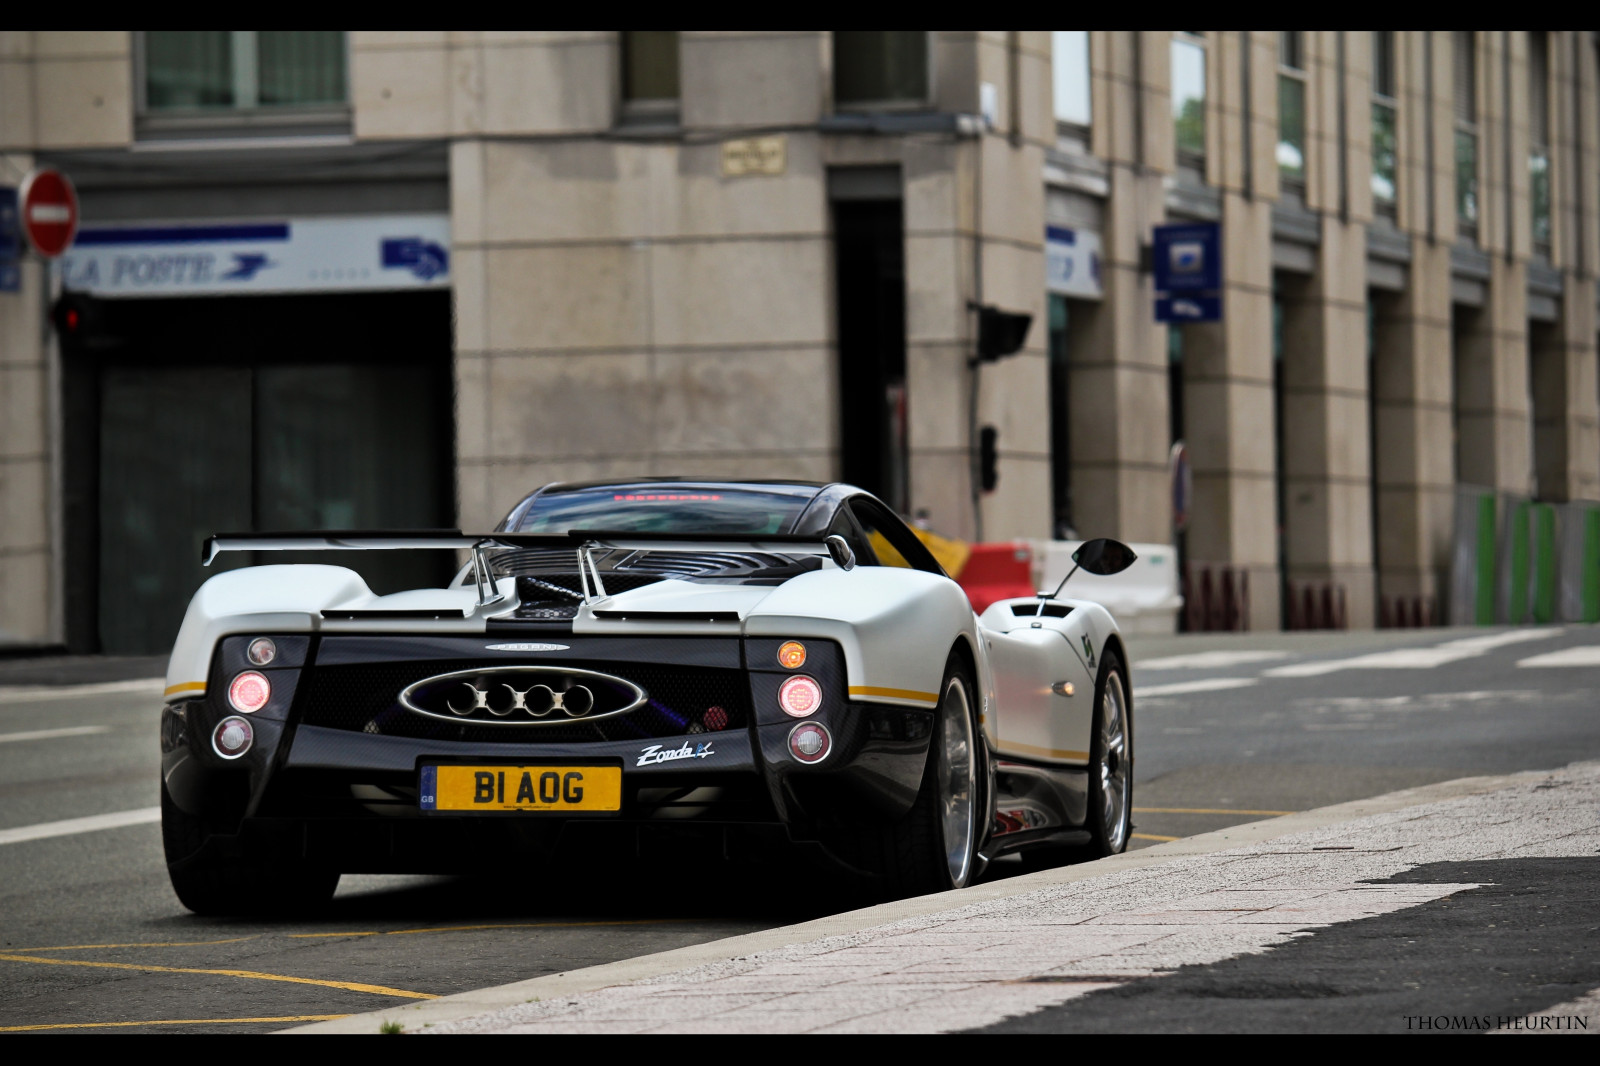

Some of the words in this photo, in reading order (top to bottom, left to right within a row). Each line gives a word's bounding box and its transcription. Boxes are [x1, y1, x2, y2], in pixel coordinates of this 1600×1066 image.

[60, 256, 99, 285] LA
[112, 252, 216, 285] POSTE
[636, 740, 694, 767] Zonda
[421, 795, 434, 803] GB
[516, 771, 584, 804] AOG
